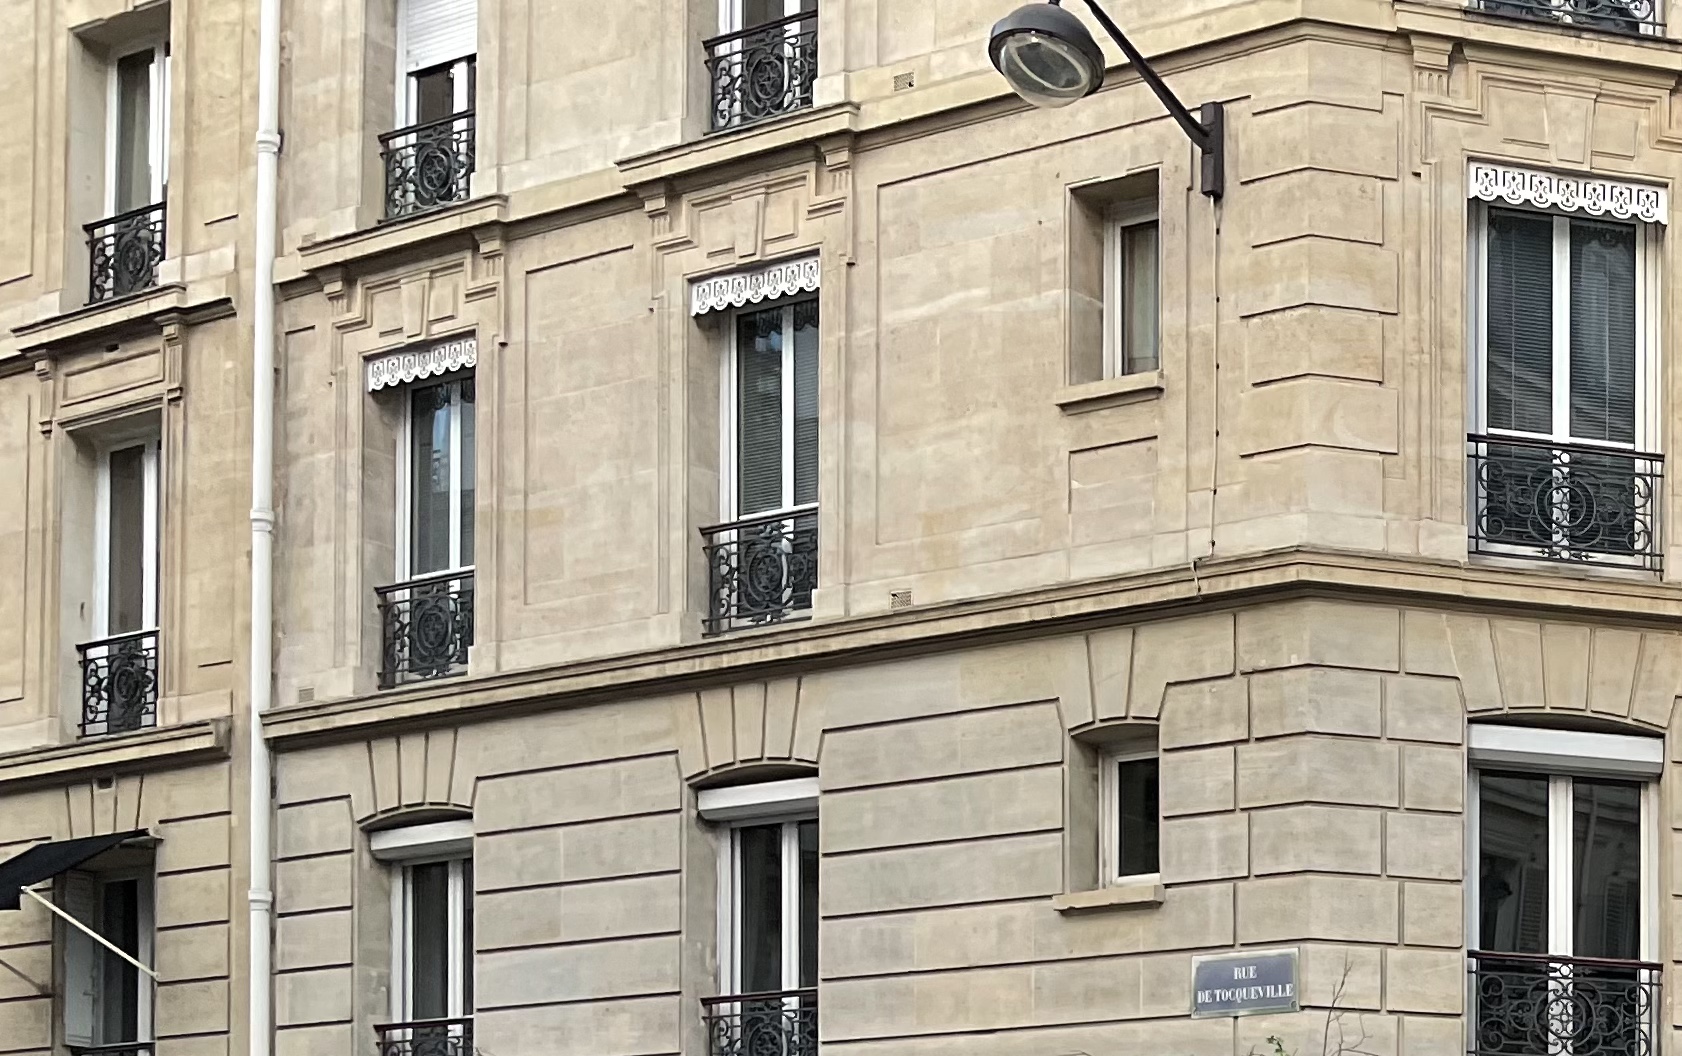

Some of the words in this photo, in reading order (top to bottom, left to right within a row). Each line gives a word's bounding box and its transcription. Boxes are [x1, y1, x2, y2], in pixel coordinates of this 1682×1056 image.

[1233, 966, 1257, 980] RUE
[1197, 990, 1213, 1004] DE
[1214, 983, 1294, 1003] TOCQUEVILLE
